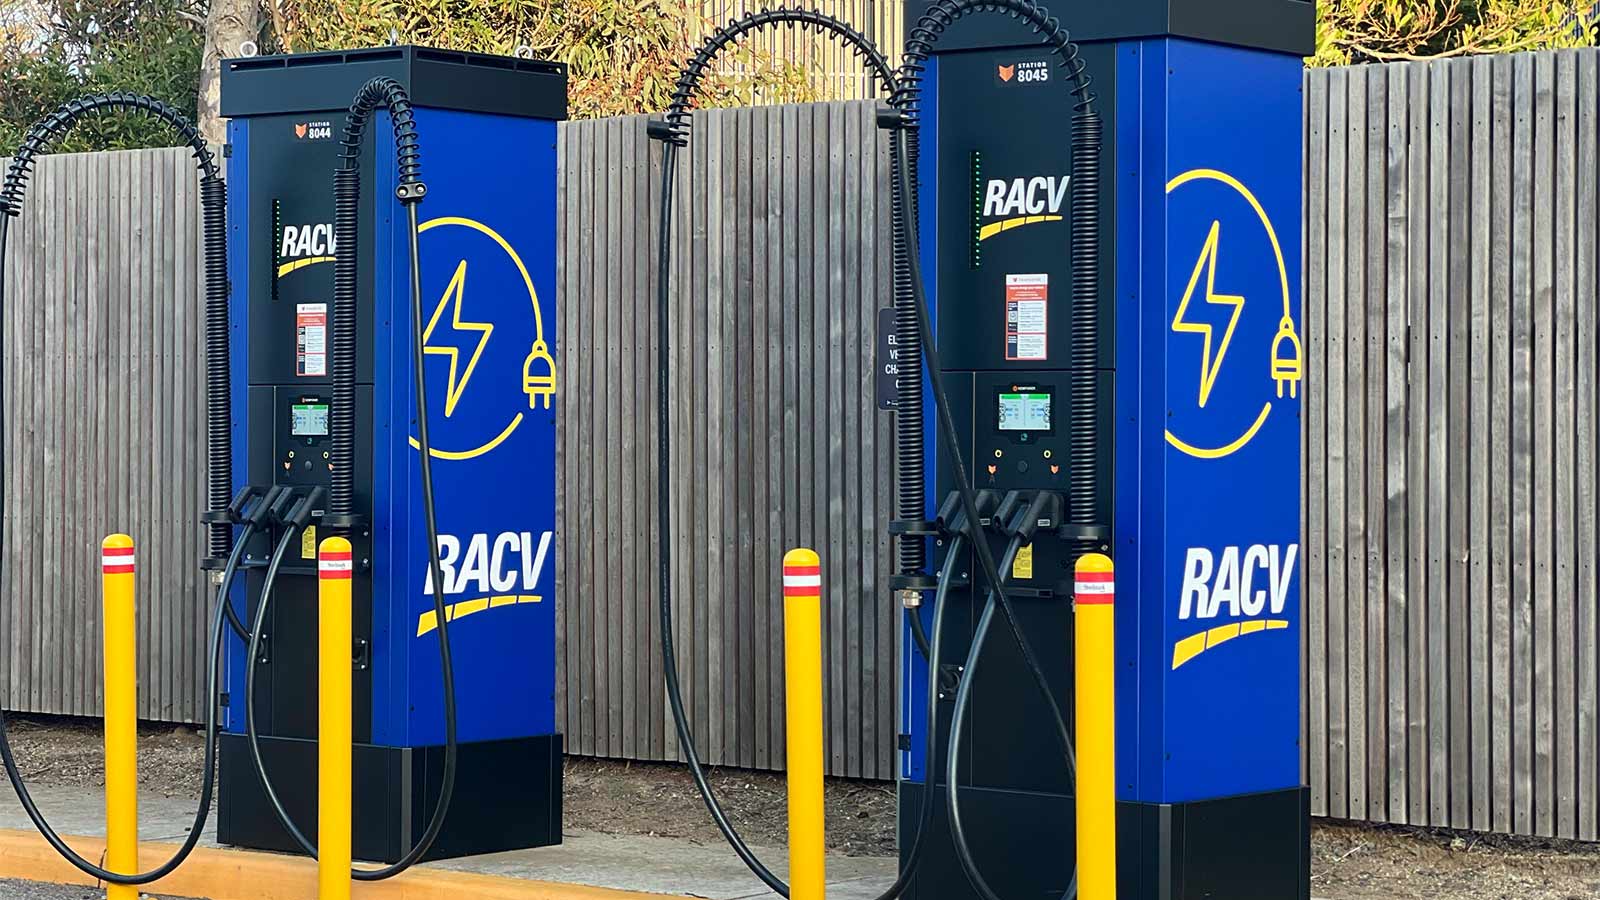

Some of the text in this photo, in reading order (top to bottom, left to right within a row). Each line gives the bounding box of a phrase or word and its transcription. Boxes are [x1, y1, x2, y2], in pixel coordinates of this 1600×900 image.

[1018, 69, 1048, 82] 8045
[309, 128, 330, 138] 8044
[983, 176, 1070, 216] RACV
[423, 531, 553, 595] RACV
[1178, 544, 1298, 620] RACV
